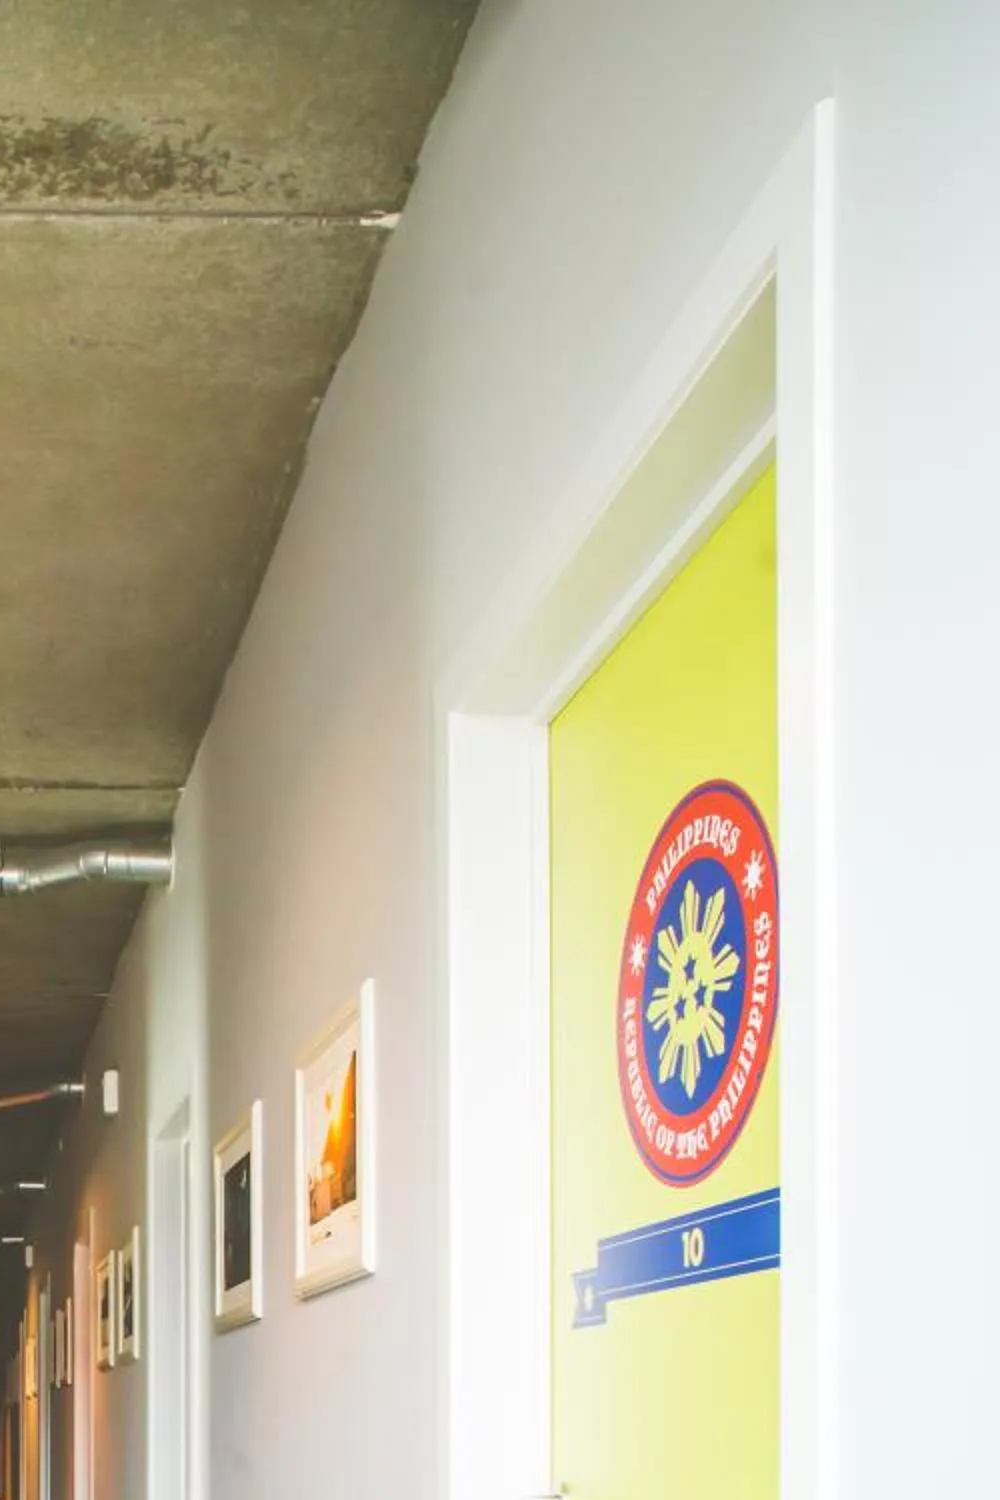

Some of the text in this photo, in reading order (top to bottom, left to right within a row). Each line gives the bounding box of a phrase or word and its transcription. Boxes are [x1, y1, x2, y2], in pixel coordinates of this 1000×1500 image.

[645, 814, 741, 917] PHILIPPINES
[655, 1123, 676, 1157] OF
[675, 1121, 710, 1160] THE
[707, 911, 772, 1142] PHILIPPINES
[681, 1226, 705, 1268] 10
